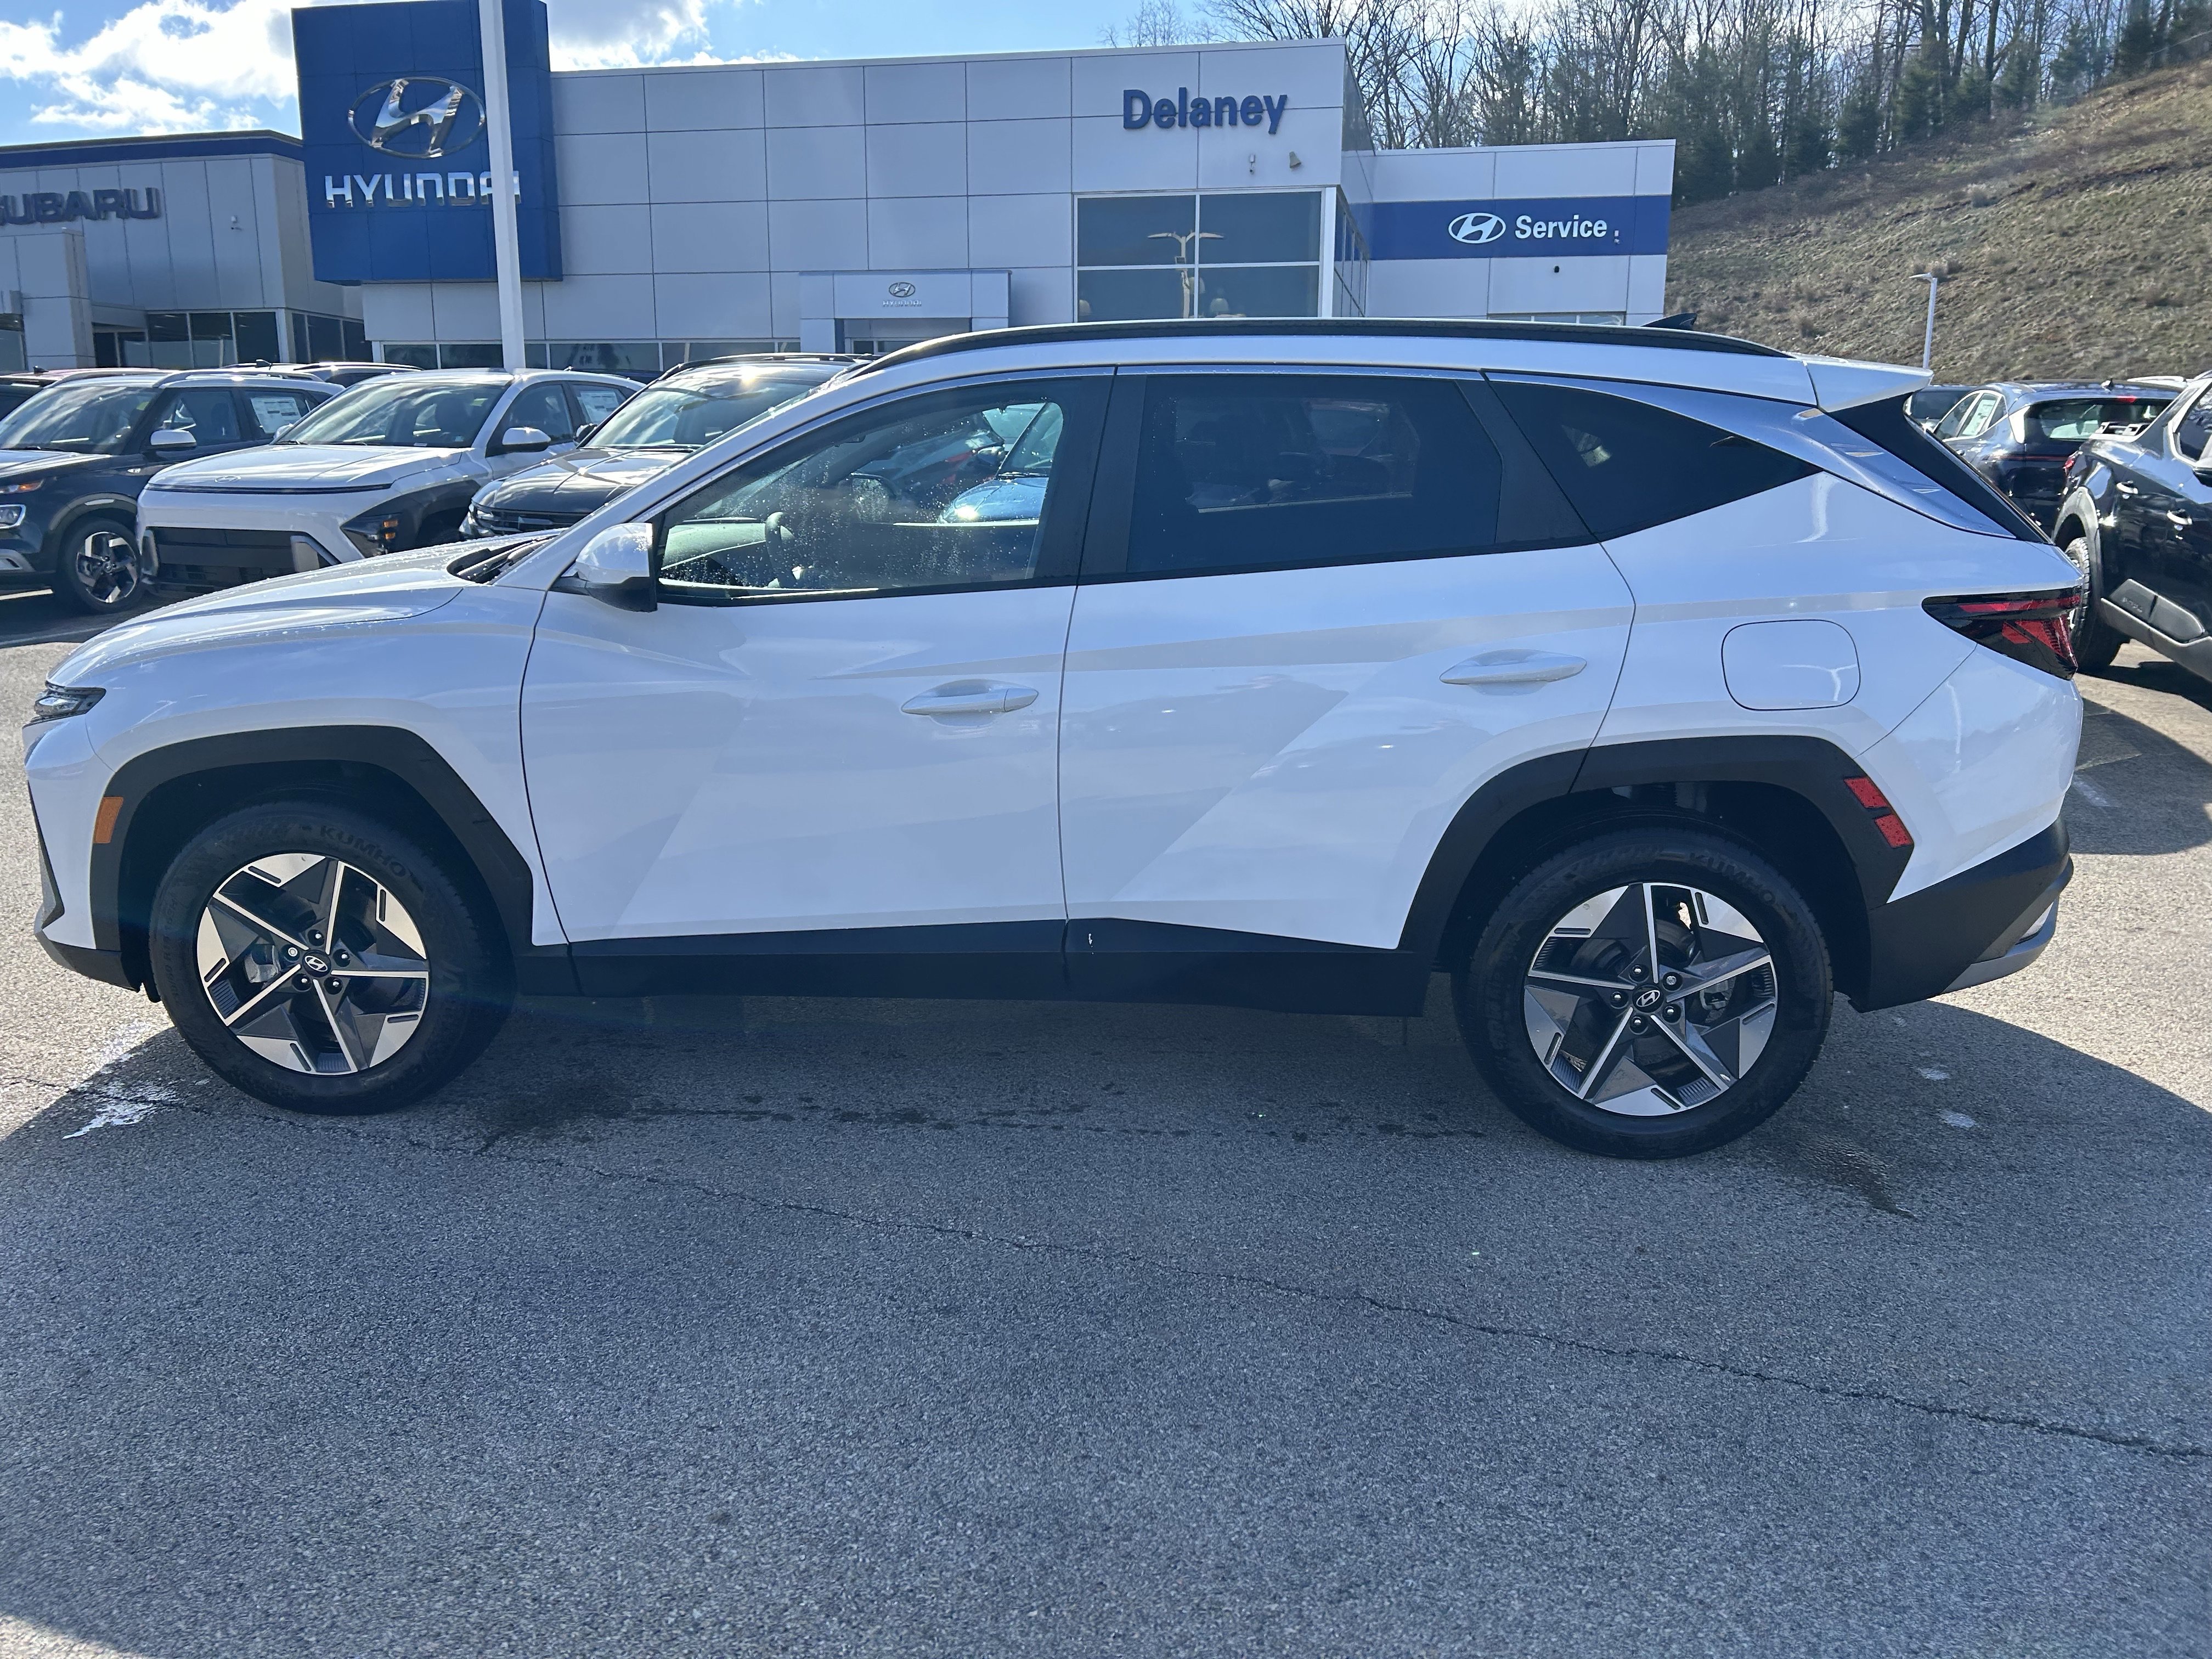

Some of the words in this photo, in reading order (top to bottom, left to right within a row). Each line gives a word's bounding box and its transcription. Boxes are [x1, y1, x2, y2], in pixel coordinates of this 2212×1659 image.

[1124, 87, 1288, 135] Delaney
[0, 187, 161, 225] UBARU
[1514, 214, 1607, 239] Service
[320, 825, 406, 877] KUMHO
